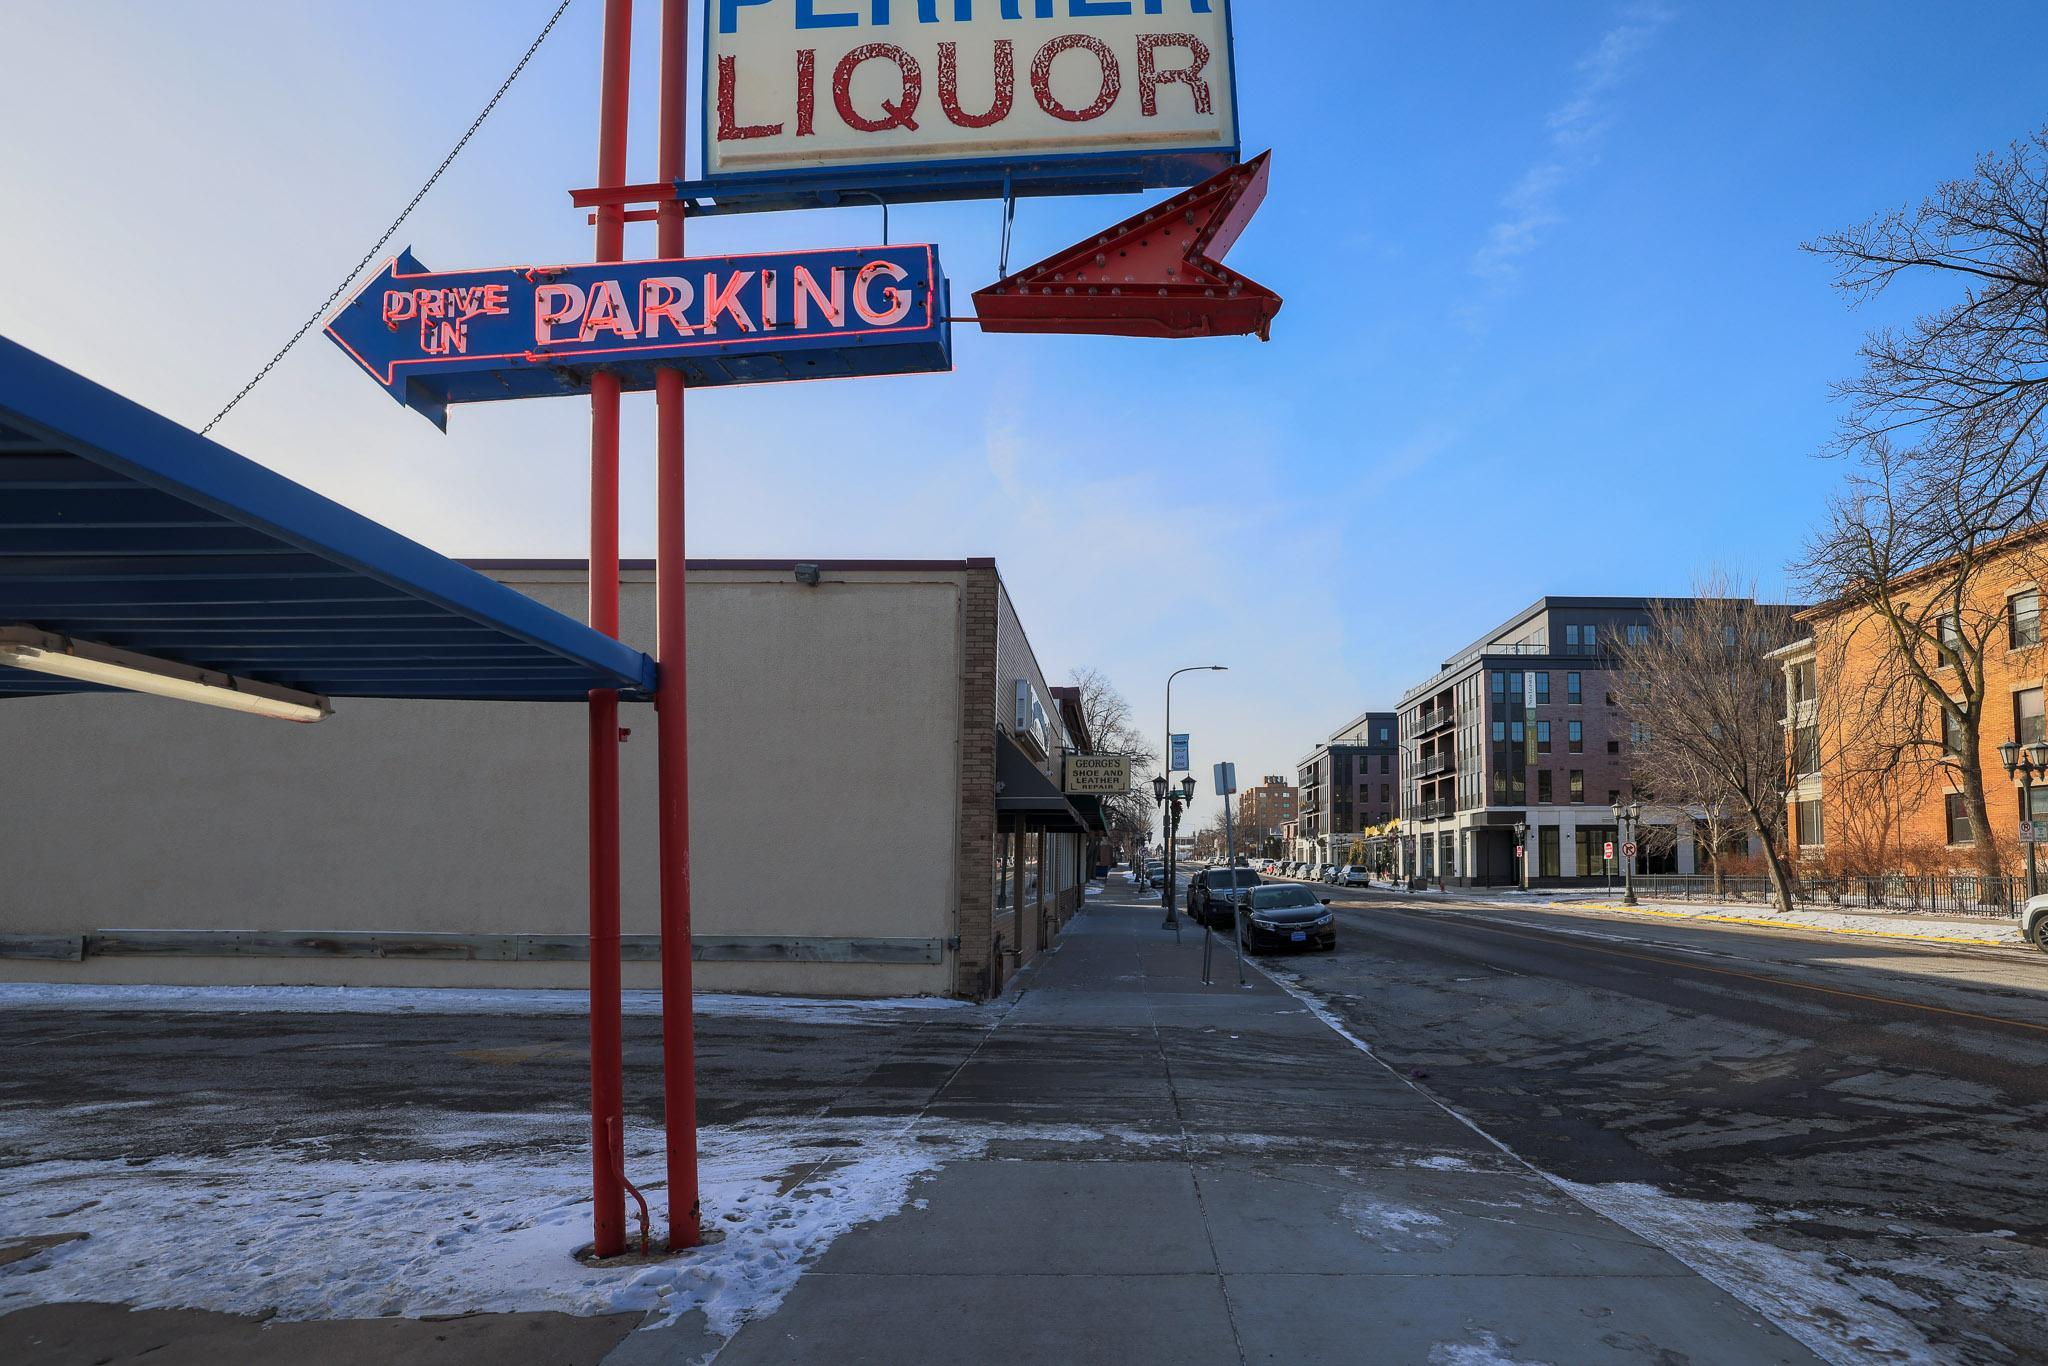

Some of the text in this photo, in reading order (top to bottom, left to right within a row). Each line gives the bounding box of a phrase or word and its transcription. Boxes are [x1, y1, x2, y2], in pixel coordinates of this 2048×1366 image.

[717, 33, 1214, 142] LIQUOR
[383, 284, 510, 321] DRIVE
[535, 261, 913, 345] PARKING
[422, 321, 468, 356] IN
[1072, 769, 1123, 777] SHOE AND
[1075, 758, 1121, 768] GEORGE'S
